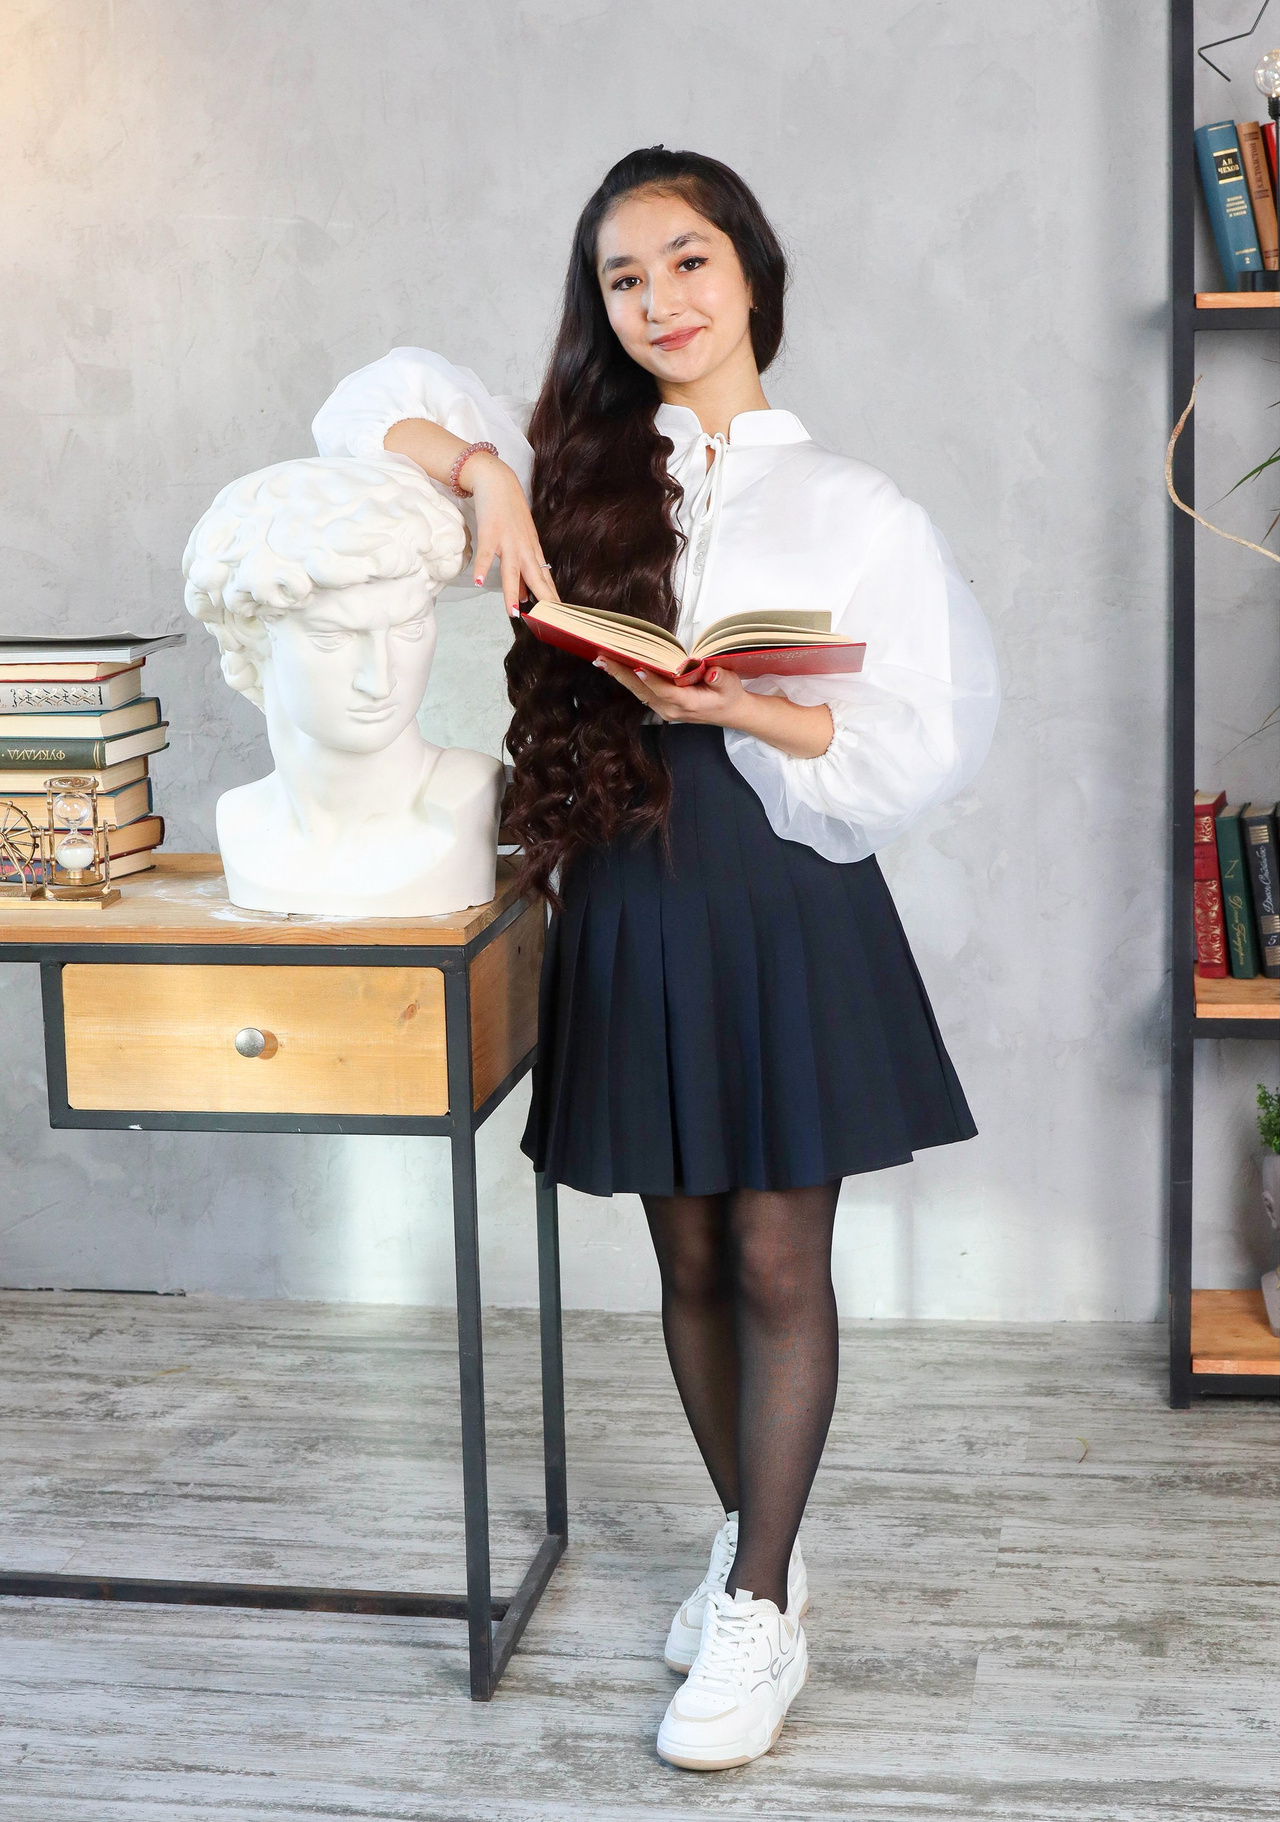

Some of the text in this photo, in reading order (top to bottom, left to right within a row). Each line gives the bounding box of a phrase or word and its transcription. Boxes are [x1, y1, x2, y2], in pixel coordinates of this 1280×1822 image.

[1217, 164, 1240, 174] ЧЕХОВ
[7, 748, 66, 761] ФУКИДИД
[1262, 885, 1275, 914] Джон
[1267, 935, 1277, 945] 5
